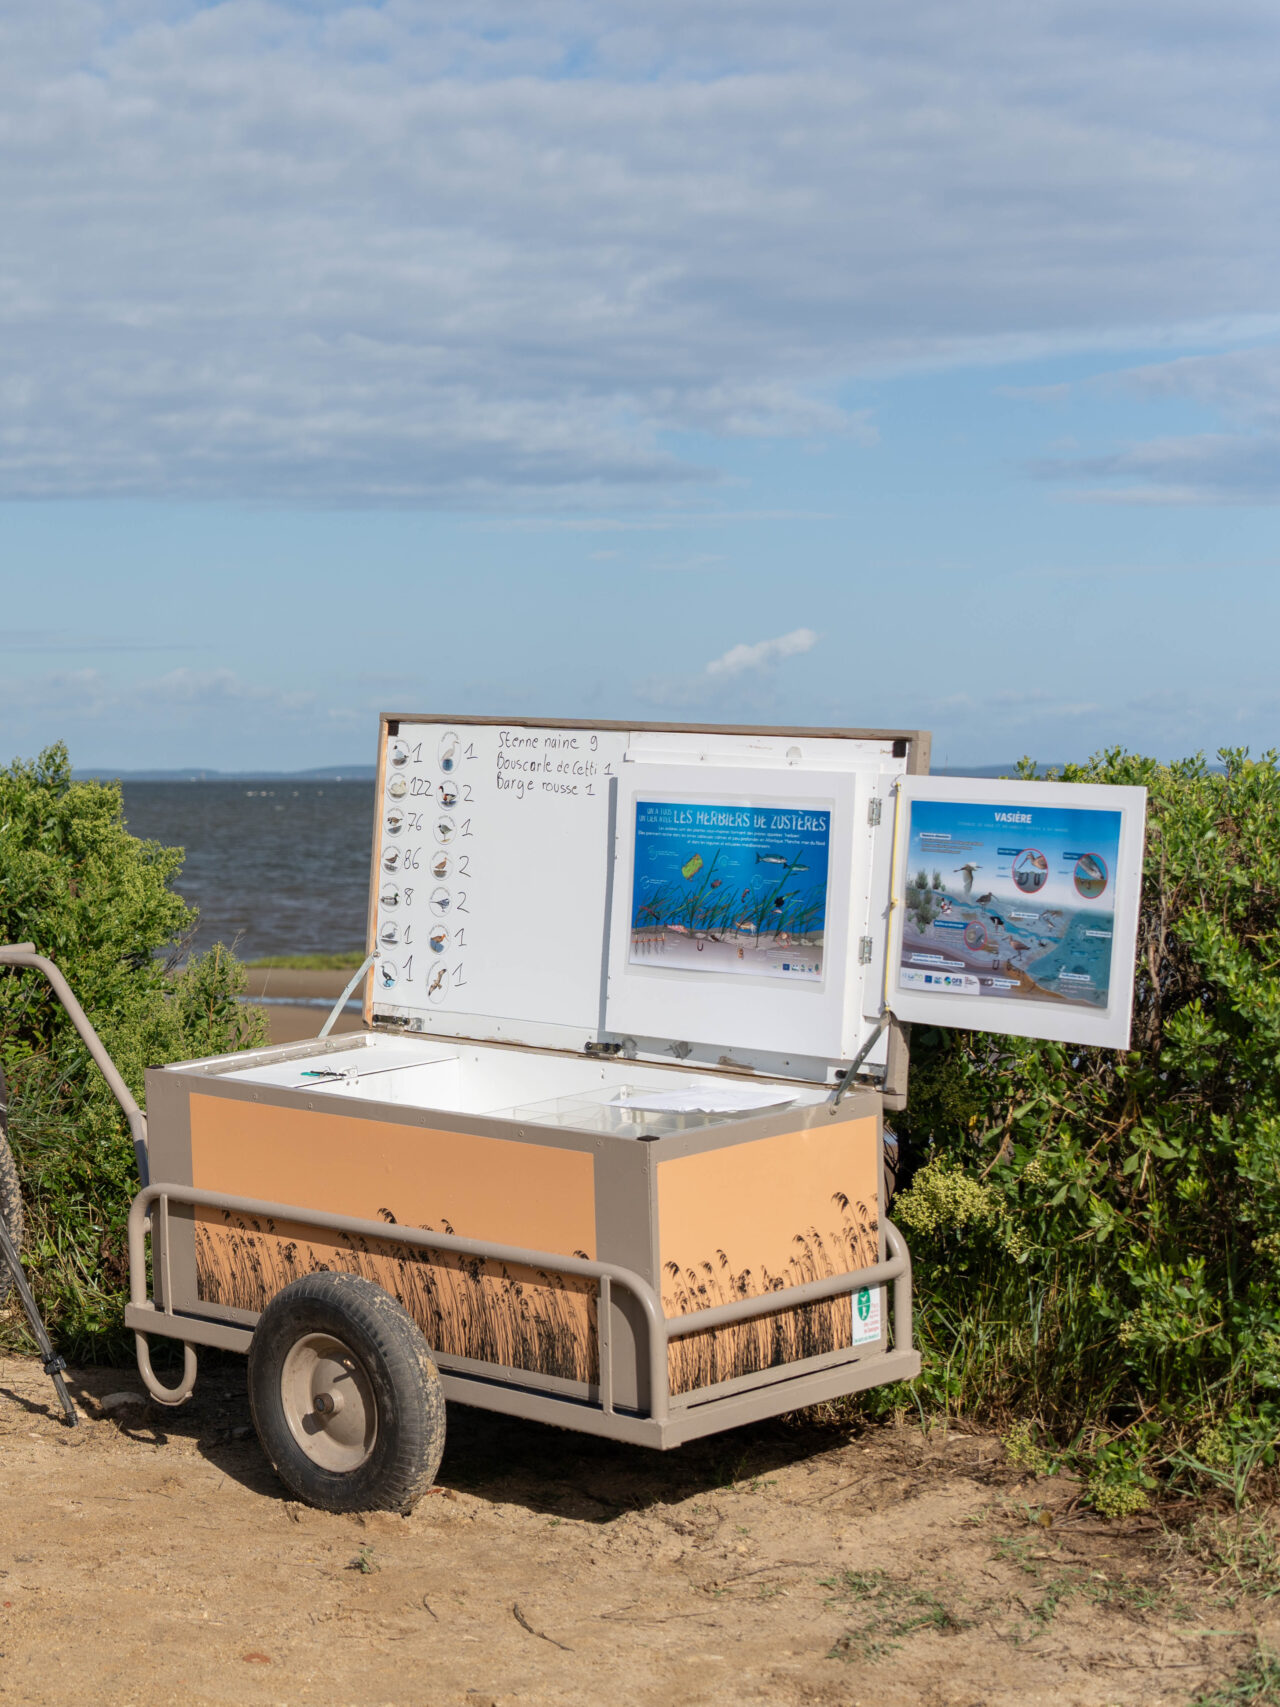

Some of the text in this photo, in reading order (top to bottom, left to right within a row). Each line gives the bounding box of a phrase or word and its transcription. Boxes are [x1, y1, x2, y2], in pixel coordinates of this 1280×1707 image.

[464, 742, 478, 760] 1
[498, 731, 539, 749] Sterne
[544, 734, 580, 750] naine
[412, 742, 423, 763] 1
[496, 751, 614, 777] Bouscarle de Cetti 1
[410, 776, 434, 797] 122
[462, 784, 474, 802] 2
[496, 771, 596, 800] Barge rousse 1
[407, 812, 424, 832] 76
[461, 818, 473, 837] 1
[673, 809, 693, 824] LES
[695, 810, 750, 827] HERBIERS
[753, 814, 767, 829] DE
[403, 847, 422, 870] 86
[458, 855, 472, 878] 2
[404, 887, 414, 906] 8
[456, 891, 470, 914] 2
[404, 924, 413, 945] 1
[454, 927, 467, 947] 1
[402, 954, 413, 982] 1
[452, 962, 467, 987] 1
